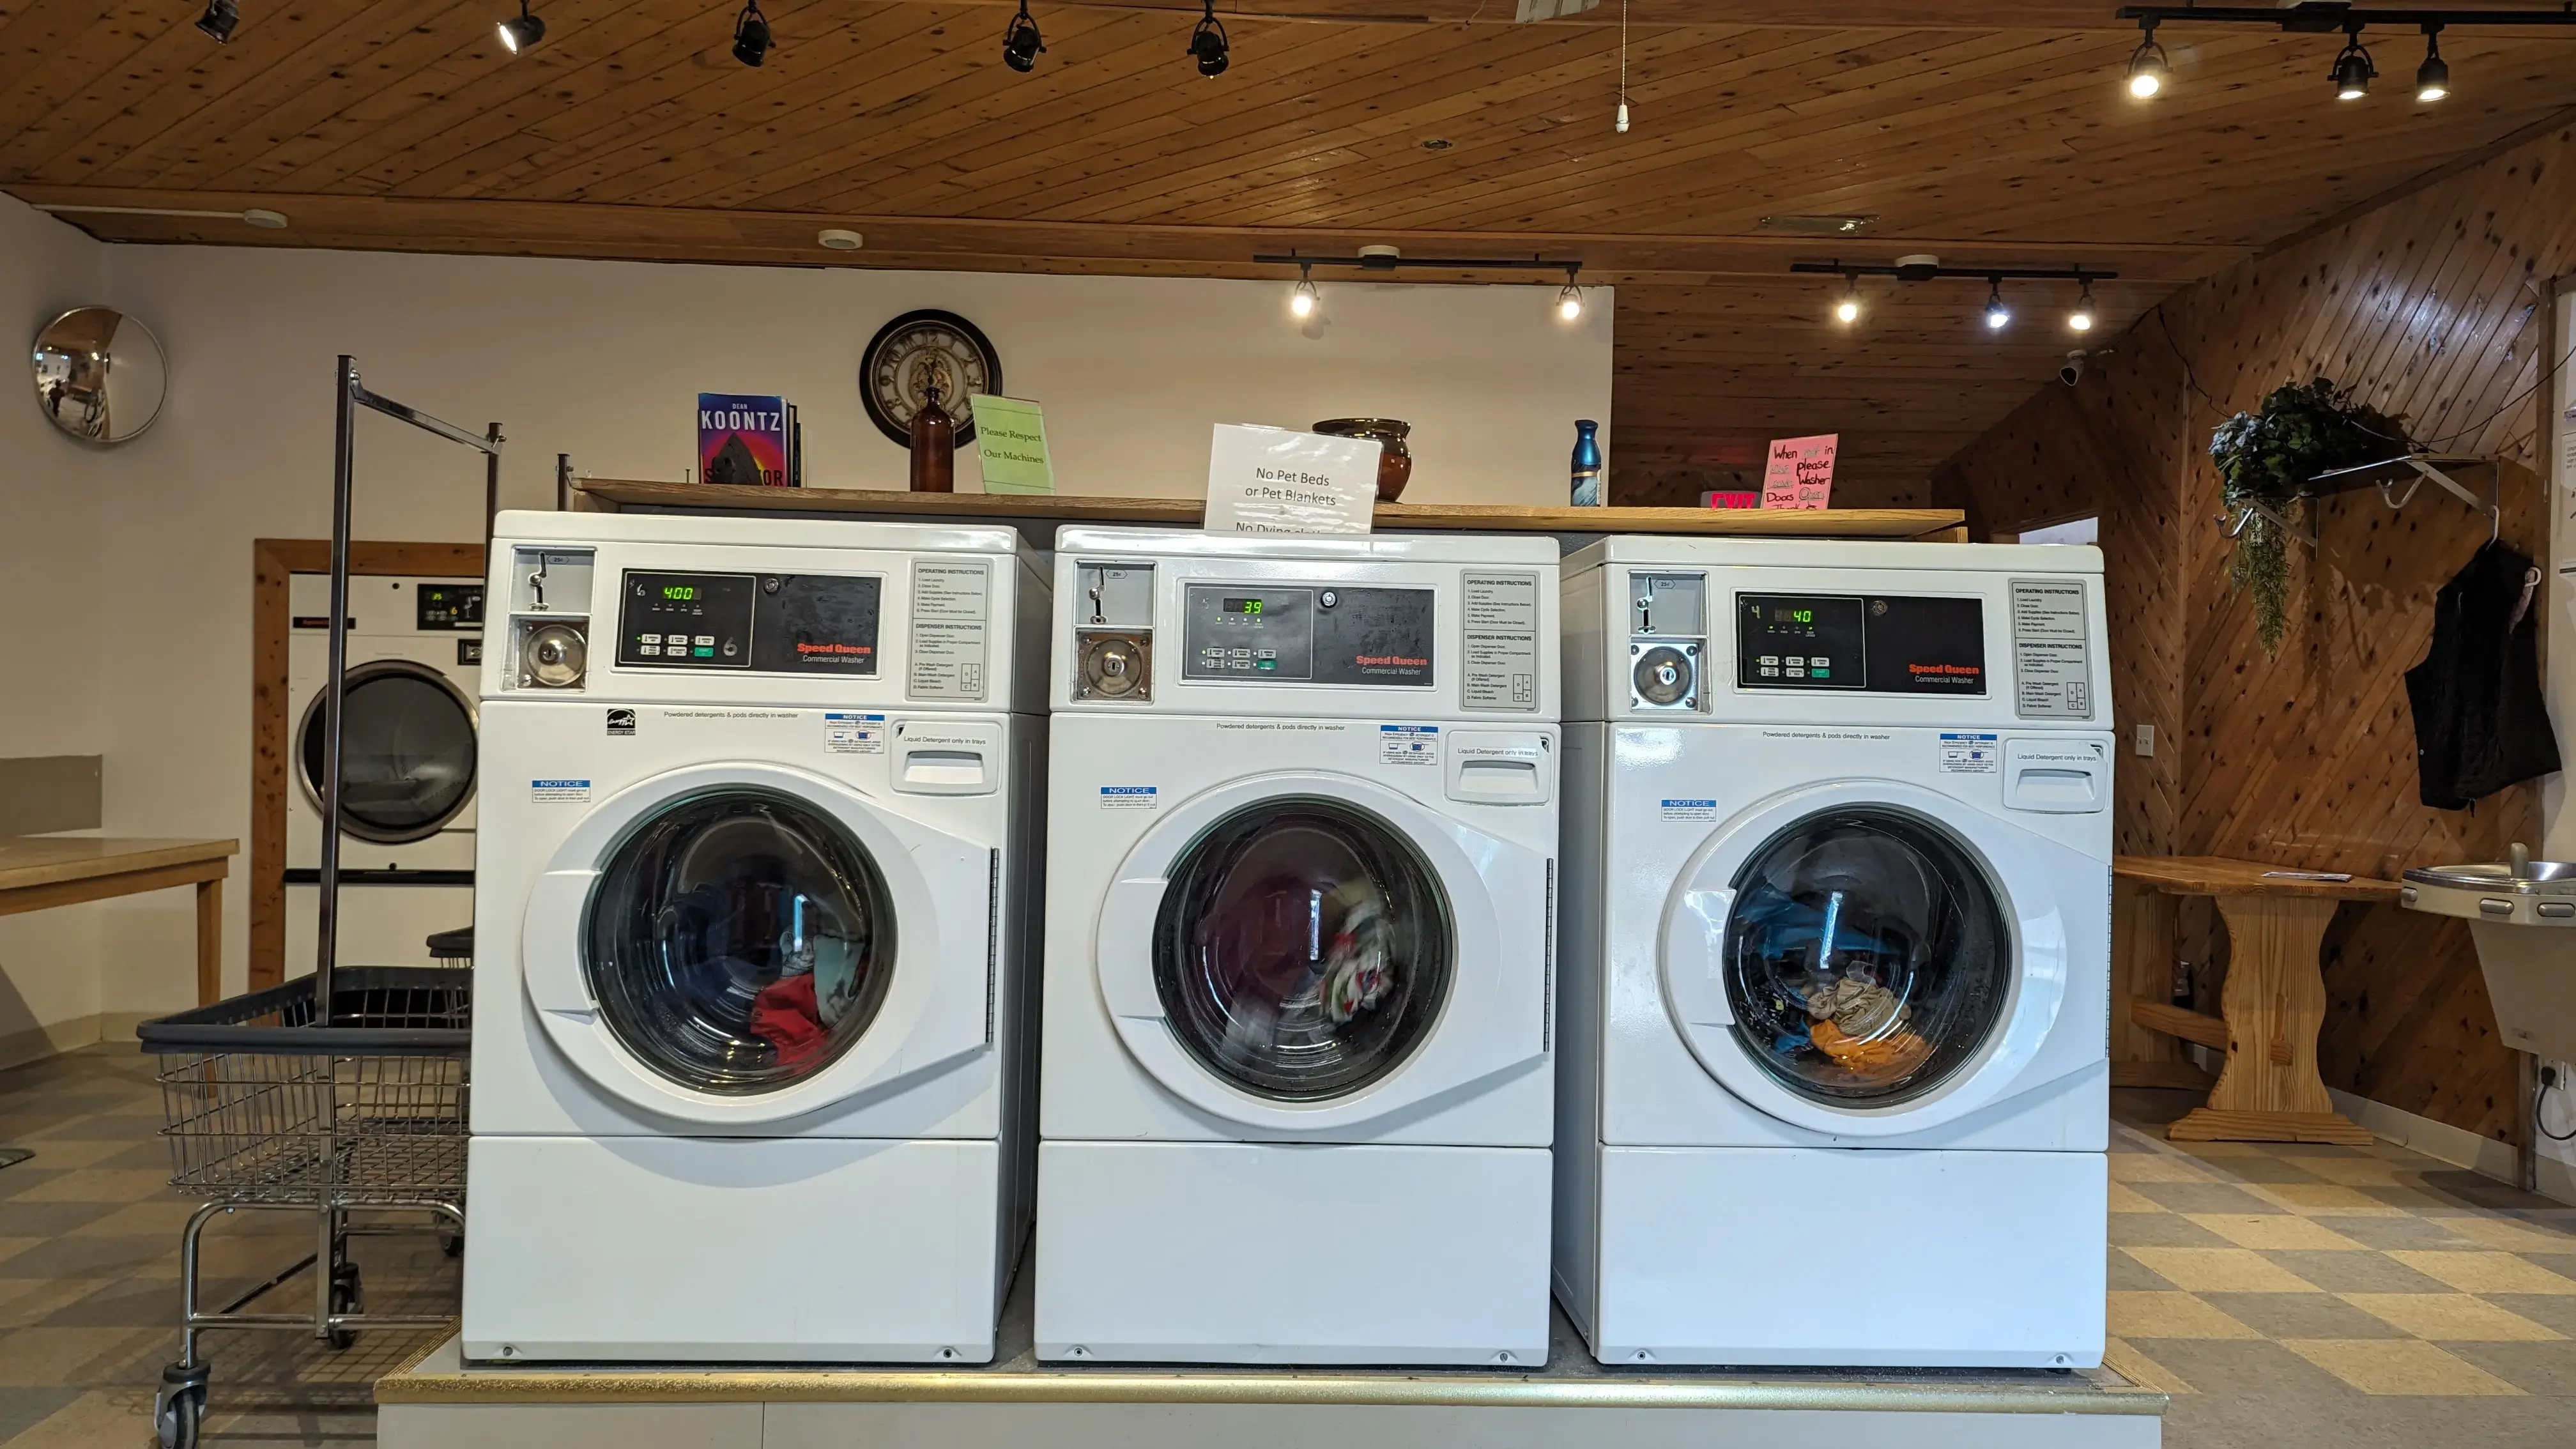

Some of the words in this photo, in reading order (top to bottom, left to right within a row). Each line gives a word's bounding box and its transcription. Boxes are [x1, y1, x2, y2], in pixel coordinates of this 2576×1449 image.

[702, 410, 781, 431] KOONTZ
[981, 427, 1008, 438] Please
[1009, 431, 1041, 442] Respect
[984, 449, 1002, 459] Our
[1004, 452, 1044, 464] Machines
[1774, 445, 1798, 459] When
[1825, 446, 1834, 455] in
[1797, 458, 1831, 477] please
[1256, 468, 1273, 480] No
[1278, 470, 1298, 482] Pet
[1301, 473, 1330, 486] Beds
[1798, 471, 1830, 485] Washer
[1245, 487, 1259, 497] or
[1262, 487, 1282, 499] Pet
[1285, 490, 1337, 506] Blankets
[1236, 522, 1253, 532] No
[637, 584, 646, 597] 6
[664, 588, 693, 600] 400
[1245, 602, 1262, 614] 39
[1751, 606, 1761, 619] 4
[1794, 611, 1811, 622] 40
[797, 643, 834, 654] Speed
[835, 644, 871, 654] Queen
[1356, 656, 1391, 666] Speed
[1392, 656, 1427, 666] Queen
[1909, 664, 1943, 674] Speed
[1945, 665, 1979, 675] Queen
[1915, 675, 1951, 684] Commercial
